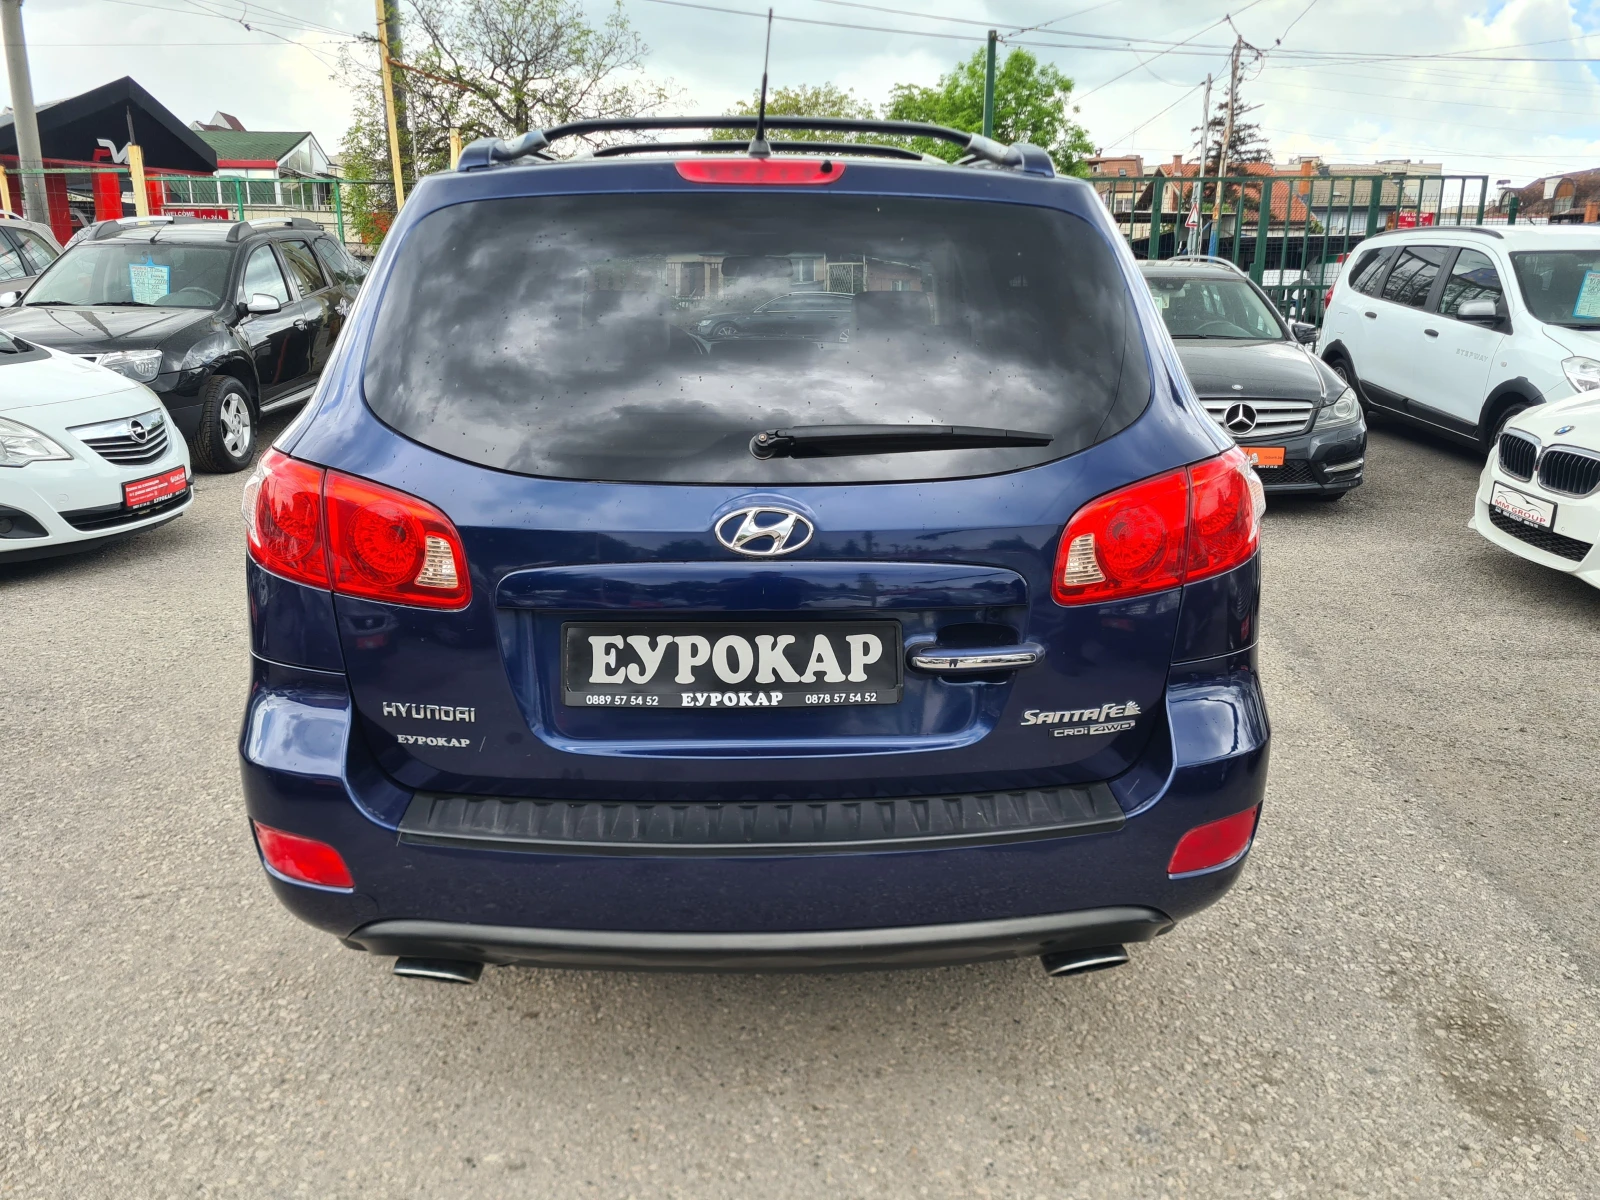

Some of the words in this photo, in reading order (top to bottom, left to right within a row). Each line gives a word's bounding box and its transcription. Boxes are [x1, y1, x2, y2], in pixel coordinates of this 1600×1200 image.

[1456, 348, 1488, 361] STEPWAY
[1495, 499, 1509, 509] MM
[1512, 506, 1546, 523] GROUP
[588, 634, 884, 685] ЕУРОКАР
[586, 695, 612, 705] 0889
[614, 695, 627, 705] 57
[630, 695, 643, 706] 54
[646, 695, 659, 706] 52
[681, 692, 783, 707] ЕУРОКАР
[805, 694, 831, 704] 0878
[833, 693, 846, 704] 57
[849, 693, 862, 703] 54
[864, 692, 877, 702] 52
[382, 701, 476, 723] HYUNDAI
[1092, 722, 1132, 733] 4WD
[397, 734, 470, 748] ЕУРОКАР
